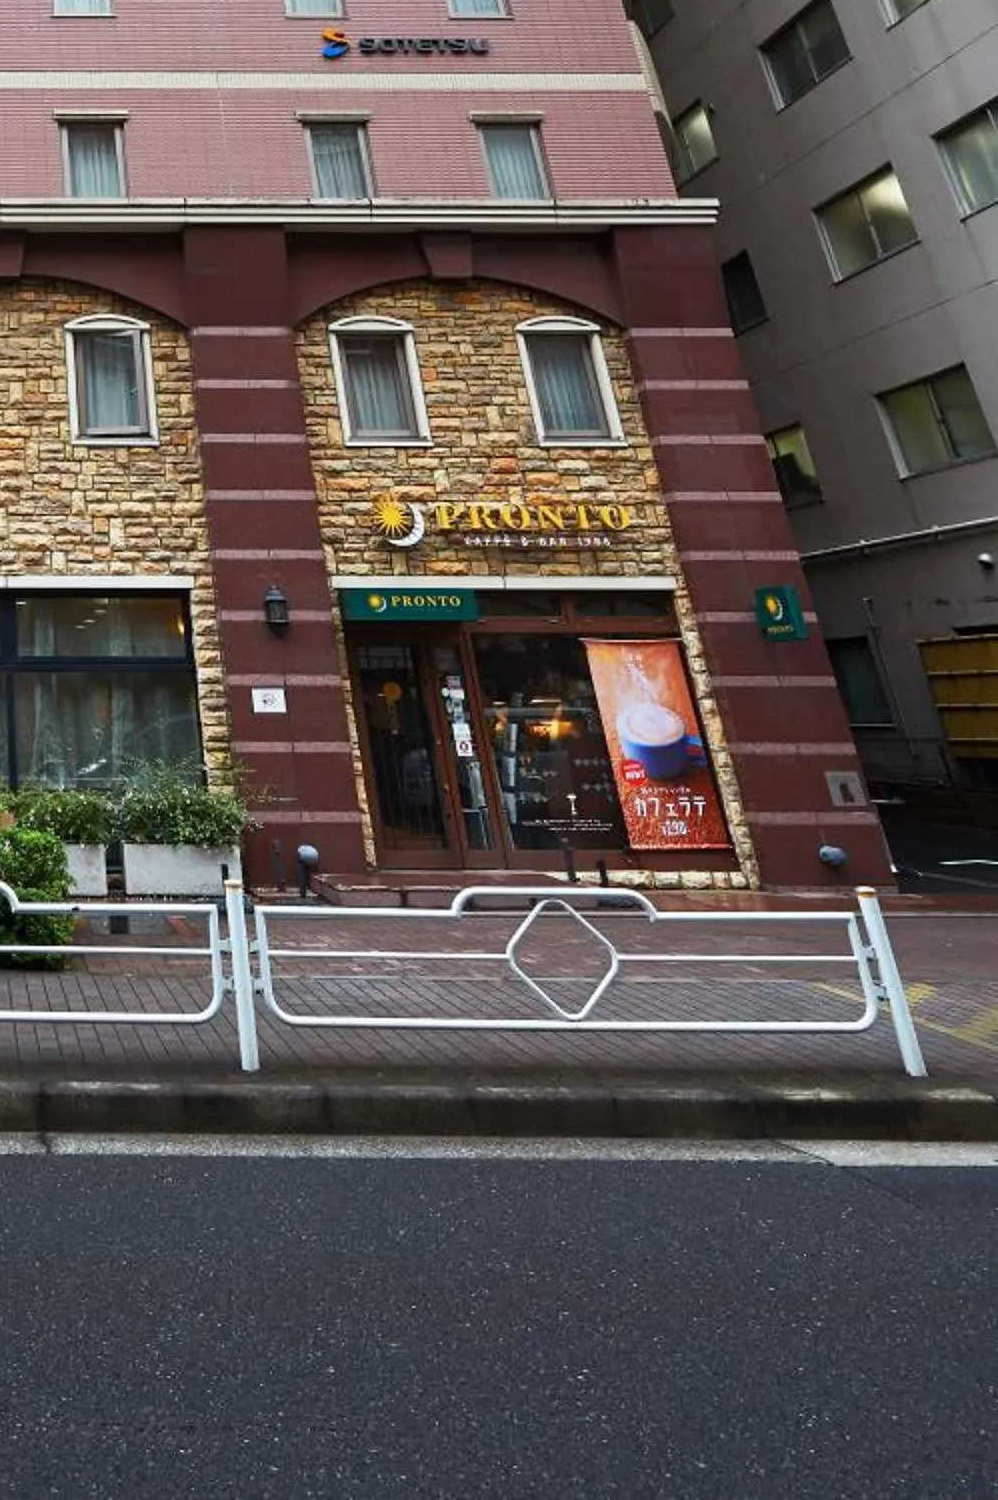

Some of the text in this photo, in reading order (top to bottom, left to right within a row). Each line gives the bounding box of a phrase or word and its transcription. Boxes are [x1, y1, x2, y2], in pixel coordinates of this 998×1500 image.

[359, 38, 489, 56] SOTETSU
[435, 503, 631, 530] PRONTO
[391, 595, 461, 607] PRONTO
[634, 795, 706, 817] カフェラテ
